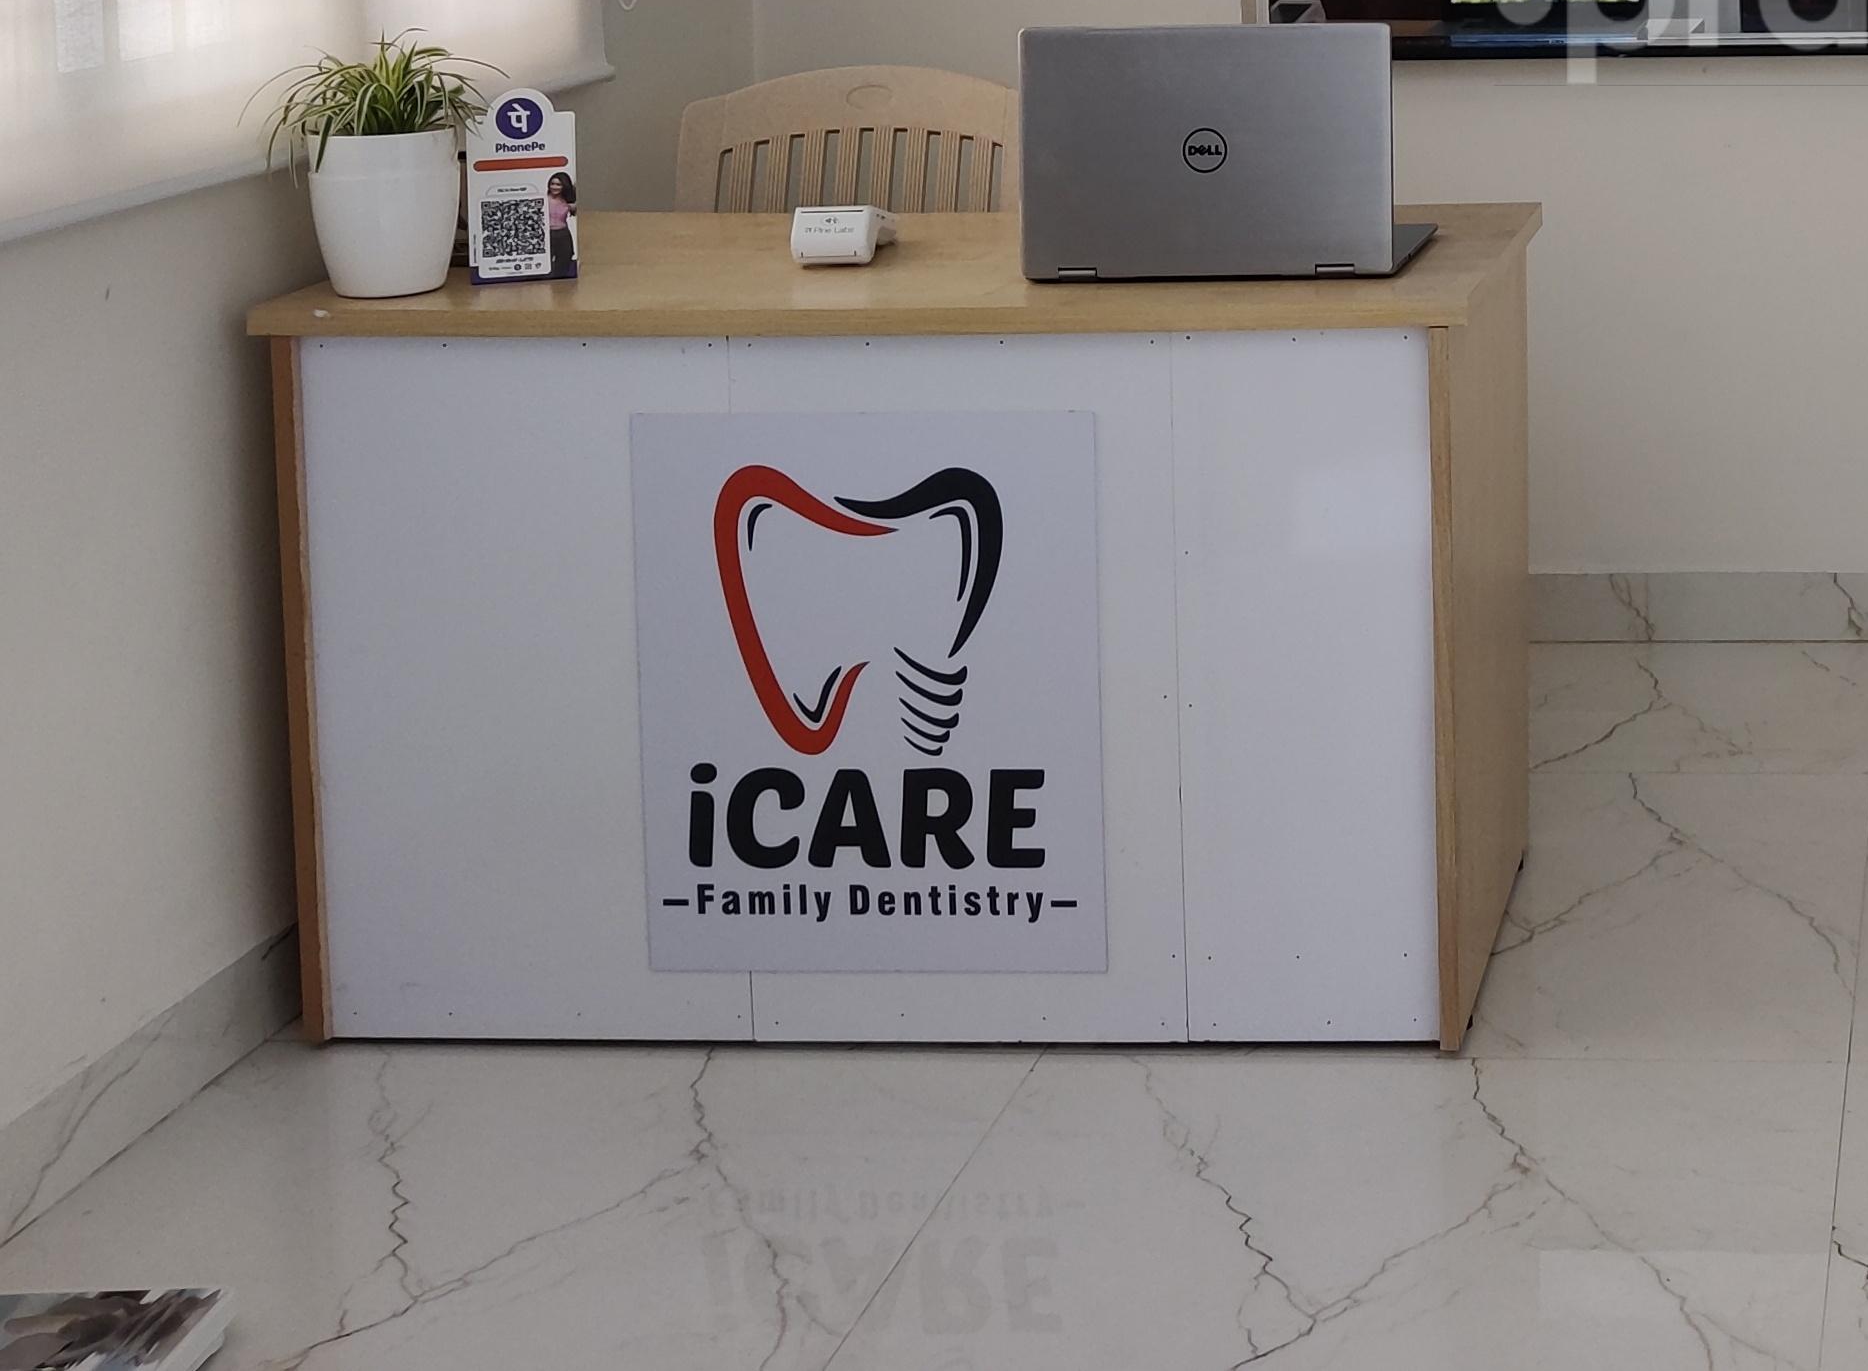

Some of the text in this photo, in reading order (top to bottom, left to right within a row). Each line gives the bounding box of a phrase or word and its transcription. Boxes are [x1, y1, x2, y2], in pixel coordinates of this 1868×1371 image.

[495, 142, 545, 153] PhonePe
[1187, 144, 1222, 156] DELL
[689, 762, 1045, 869] iCARE
[696, 884, 1043, 923] Family Dentistry
